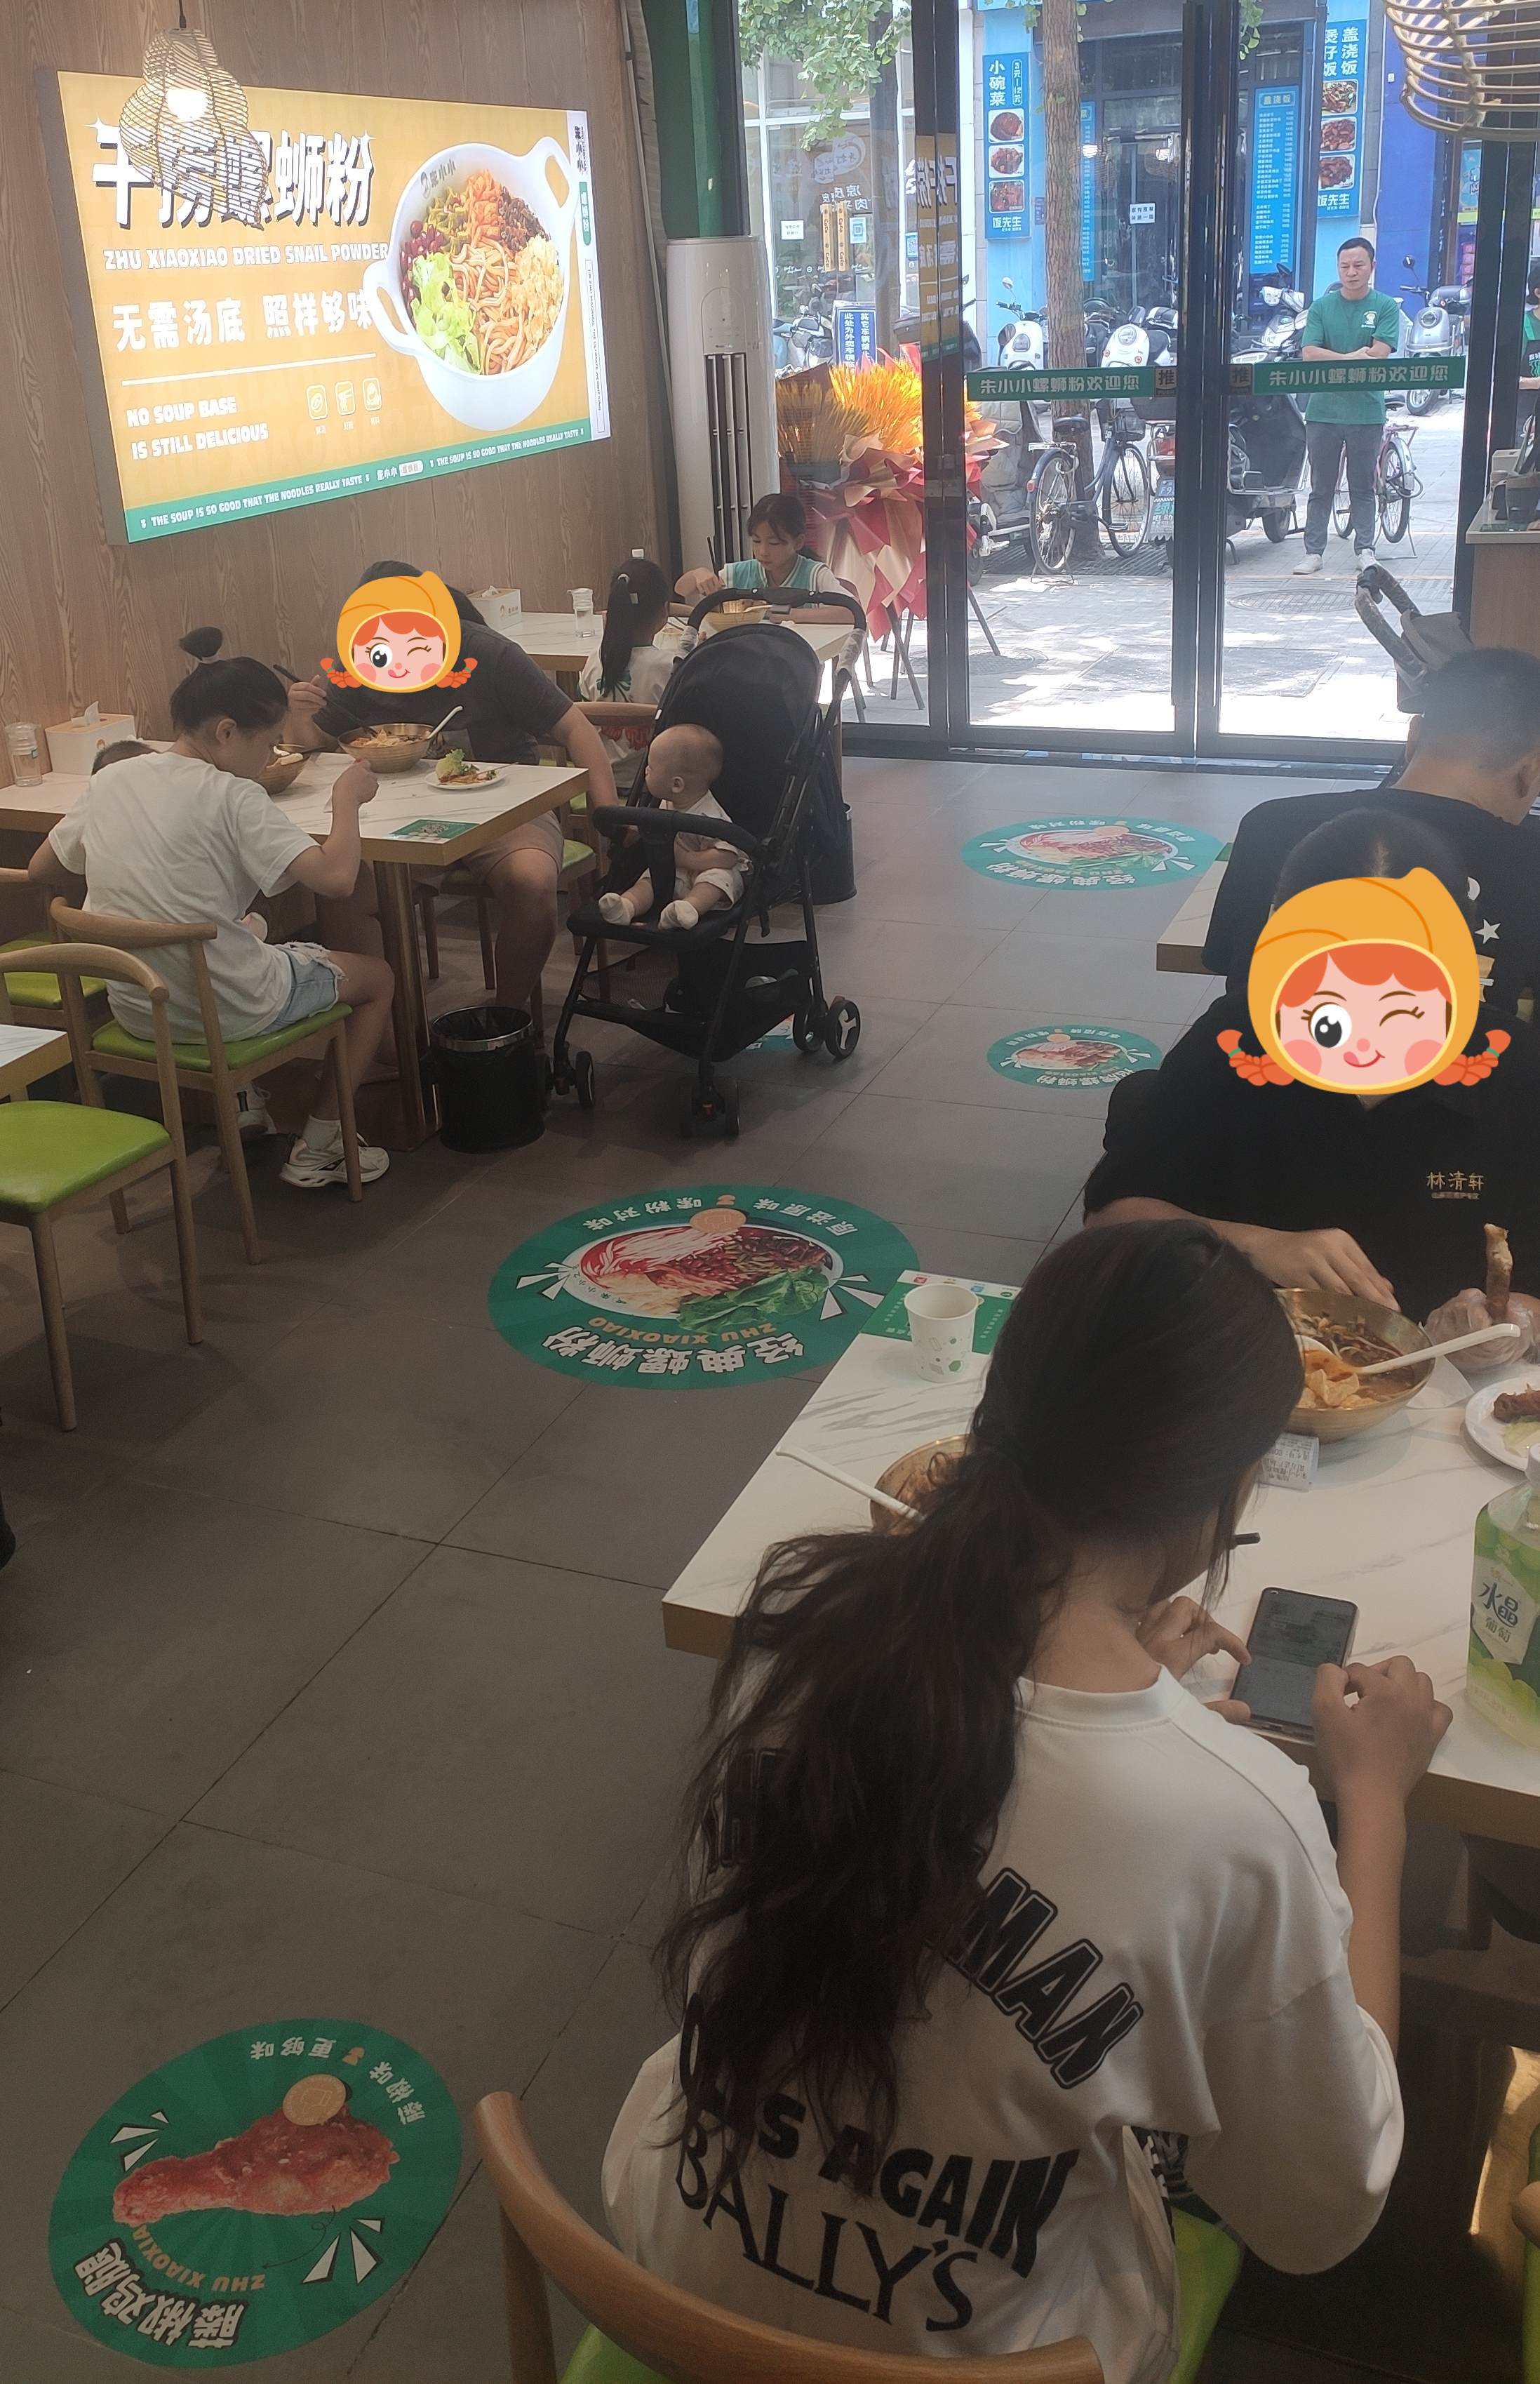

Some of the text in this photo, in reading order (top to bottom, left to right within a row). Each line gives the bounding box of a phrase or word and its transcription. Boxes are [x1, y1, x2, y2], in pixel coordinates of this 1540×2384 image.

[1341, 27, 1360, 76] 盖浇饭
[989, 60, 1006, 107] 小碗菜
[992, 217, 1022, 229] 饭先生
[103, 242, 389, 270] ZHU XIAOXIAO DRIED SNAIL POWDER
[112, 288, 375, 352] 无需汤底 照样够味
[980, 375, 1139, 394] 朱小小螺蛳粉欢迎您
[1158, 369, 1174, 385] 推
[1231, 366, 1250, 383] 推
[1269, 365, 1449, 386] 朱小小螺蛳粉欢迎您
[126, 397, 237, 427] NO SOUP BASE
[131, 422, 269, 460] IS STILL DELICIOUS
[436, 456, 448, 467] THE
[450, 451, 465, 464] SOUP
[465, 451, 472, 460] IS
[481, 446, 496, 457] GOOD
[497, 442, 511, 453] THAT
[511, 440, 522, 450] THE
[523, 436, 545, 448] NOODLES
[546, 432, 563, 443] REALLY
[563, 428, 579, 439] TASTE
[151, 474, 363, 527] THE SOUP IS SO GOOD THAT THE NOODLES REALLY TASTE
[986, 863, 1136, 886] 经典螺蛳粉
[582, 1196, 702, 1232] 嗦粉对味
[753, 1197, 858, 1237] 原滋原味
[588, 1316, 779, 1345] ZHU XIAOXIAO
[541, 1325, 805, 1376] 经典螺蛳粉
[1478, 1583, 1520, 1628] 水晶
[249, 2037, 337, 2061] 更够味
[368, 2060, 427, 2125] 藤椒味
[818, 2124, 1080, 2279] AGAIN
[676, 2126, 979, 2333] BALLY'S
[130, 2223, 266, 2292] ZHU XIAOXIA
[73, 2241, 246, 2349] 藤椒鸡腿
